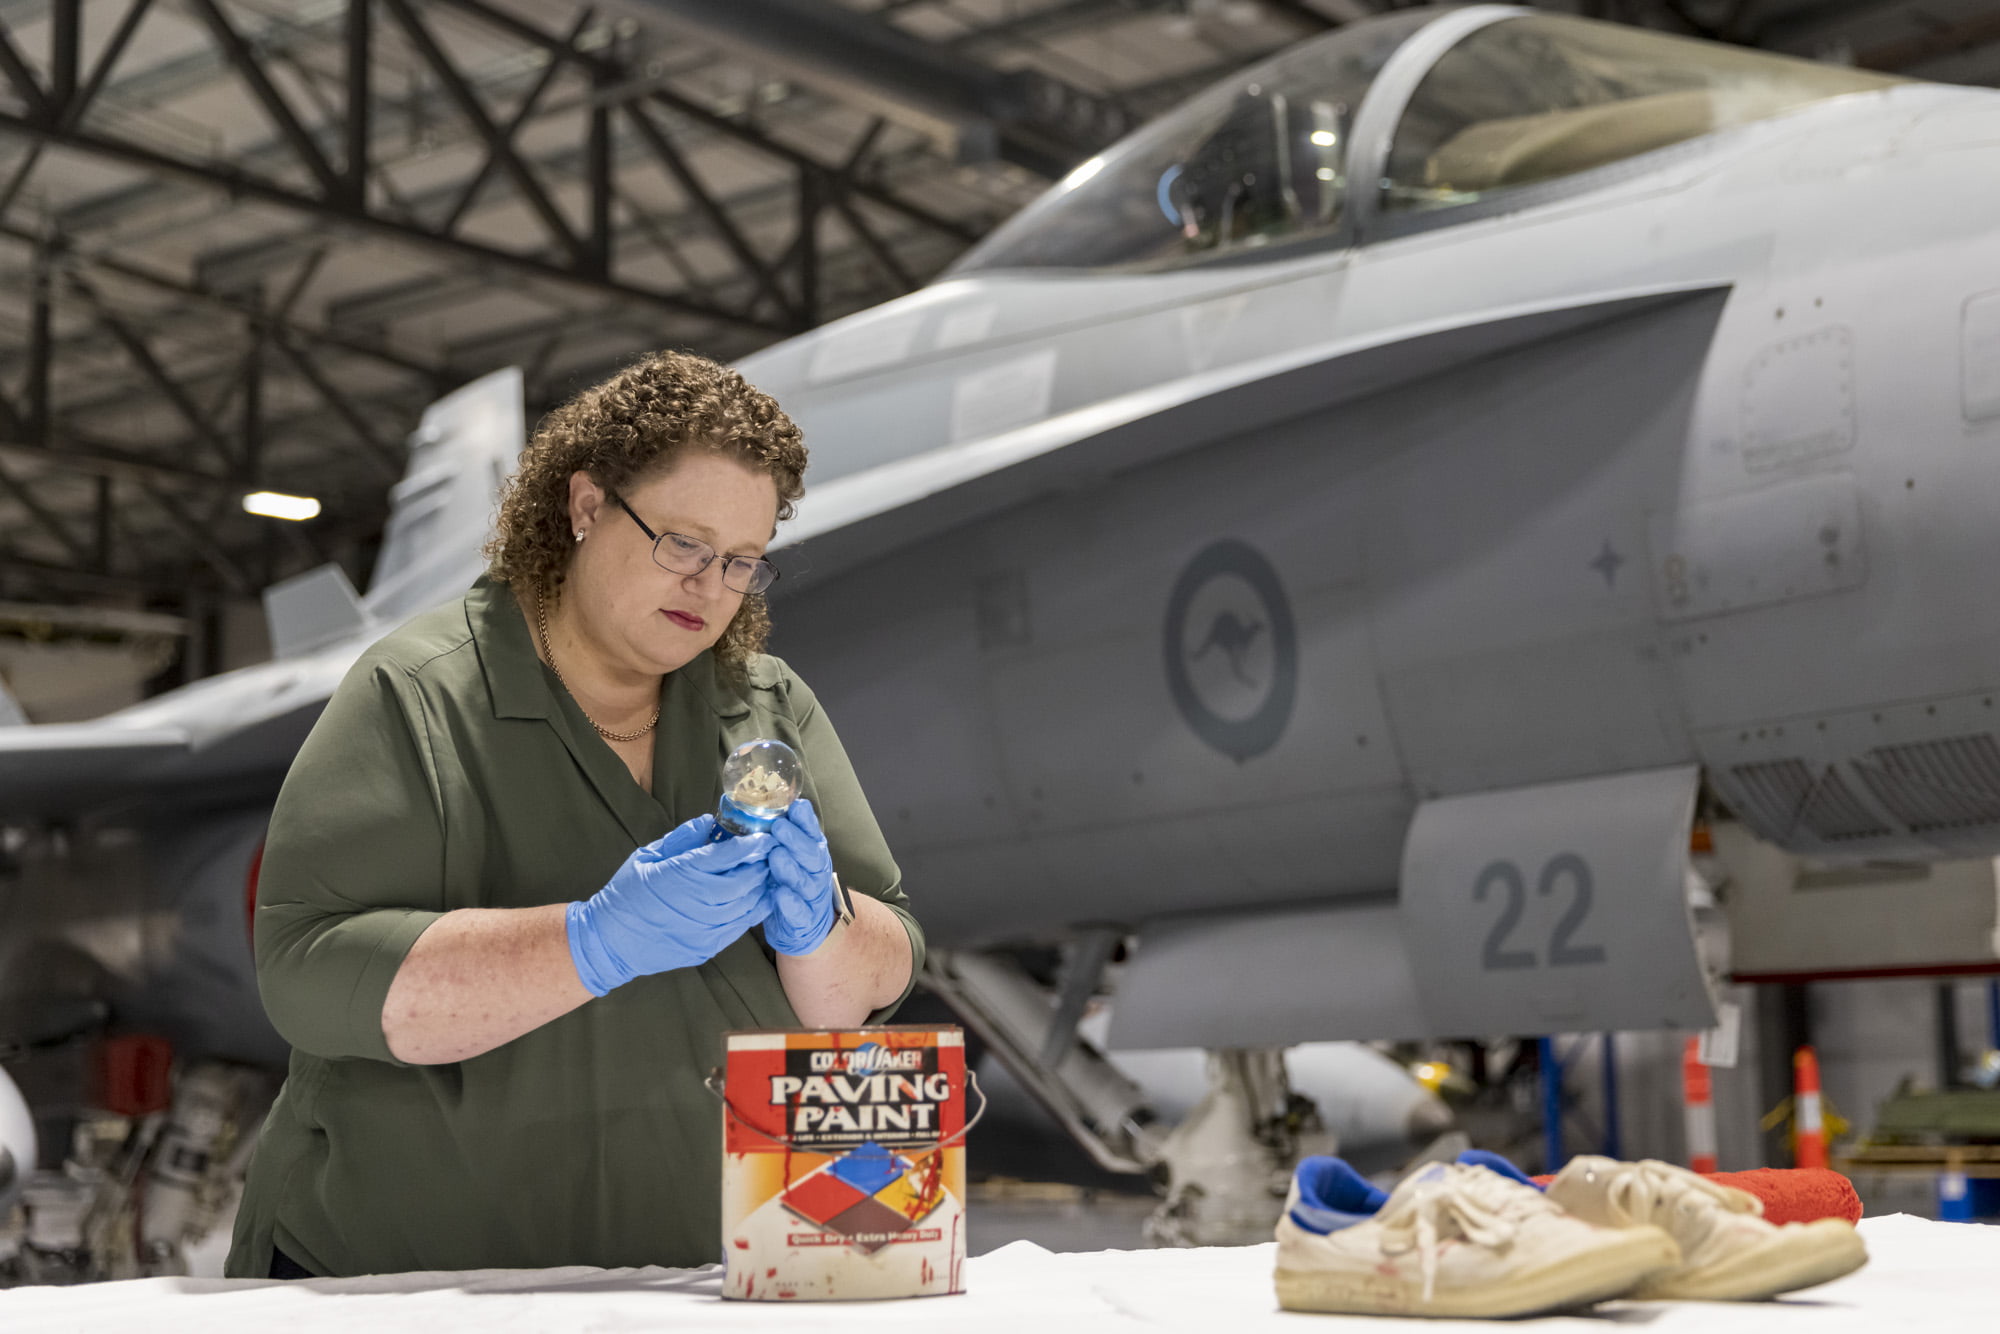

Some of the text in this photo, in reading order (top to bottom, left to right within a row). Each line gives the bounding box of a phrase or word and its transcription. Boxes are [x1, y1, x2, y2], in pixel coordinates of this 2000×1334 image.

[1473, 852, 1606, 971] 22
[771, 1073, 949, 1104] PAVING
[794, 1104, 935, 1131] PAINT
[792, 1233, 821, 1245] Quick
[824, 1233, 846, 1245] Dry
[856, 1231, 886, 1242] Extra
[919, 1229, 938, 1241] Duty
